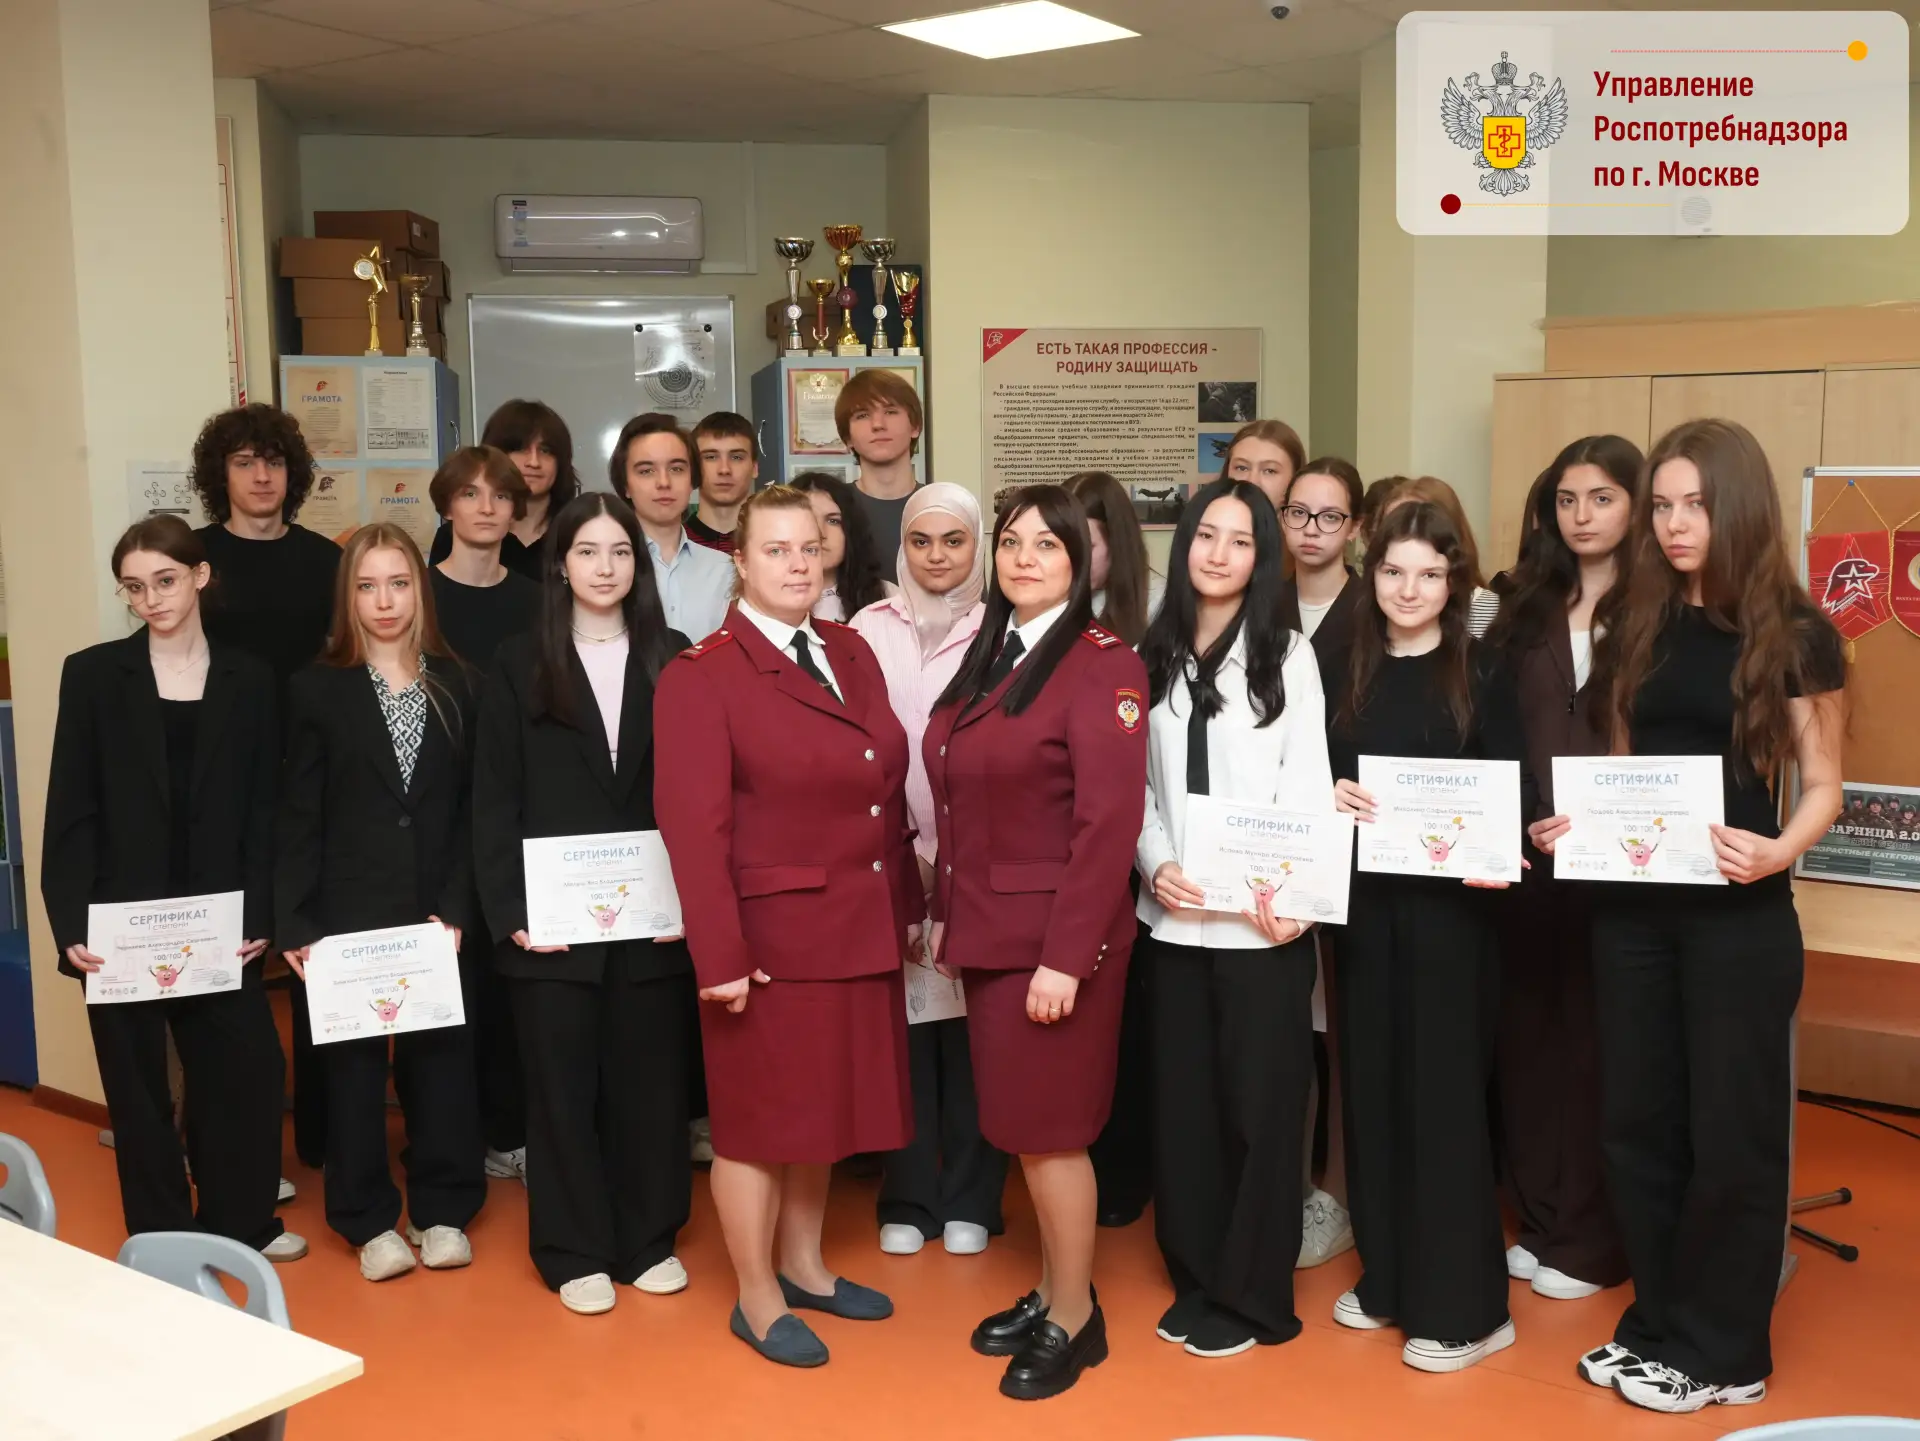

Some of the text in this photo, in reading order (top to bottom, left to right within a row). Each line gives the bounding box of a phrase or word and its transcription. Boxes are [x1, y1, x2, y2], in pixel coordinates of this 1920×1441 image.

[1036, 342, 1071, 355] ЕСТЬ
[1074, 342, 1120, 355] ТАКАЯ
[1123, 342, 1208, 355] ПРОФЕССИЯ
[1056, 361, 1198, 374] РОДИНУ ЗАЩИЩАТЬ
[1396, 773, 1478, 787] СЕРТИФИКАТ
[1594, 773, 1680, 785] СЕРТИФИКАТ
[1226, 815, 1311, 835] СЕРТИФИКАТ
[1828, 824, 1894, 840] ЗАРНИЦА
[563, 846, 641, 862] СЕРТИФИКАТ
[1808, 844, 1871, 857] ОЗРАСТНЫЕ
[129, 909, 208, 926] СЕРТИФИКАТ
[153, 922, 189, 930] степени
[342, 940, 418, 959] СЕРТИФИКАТ
